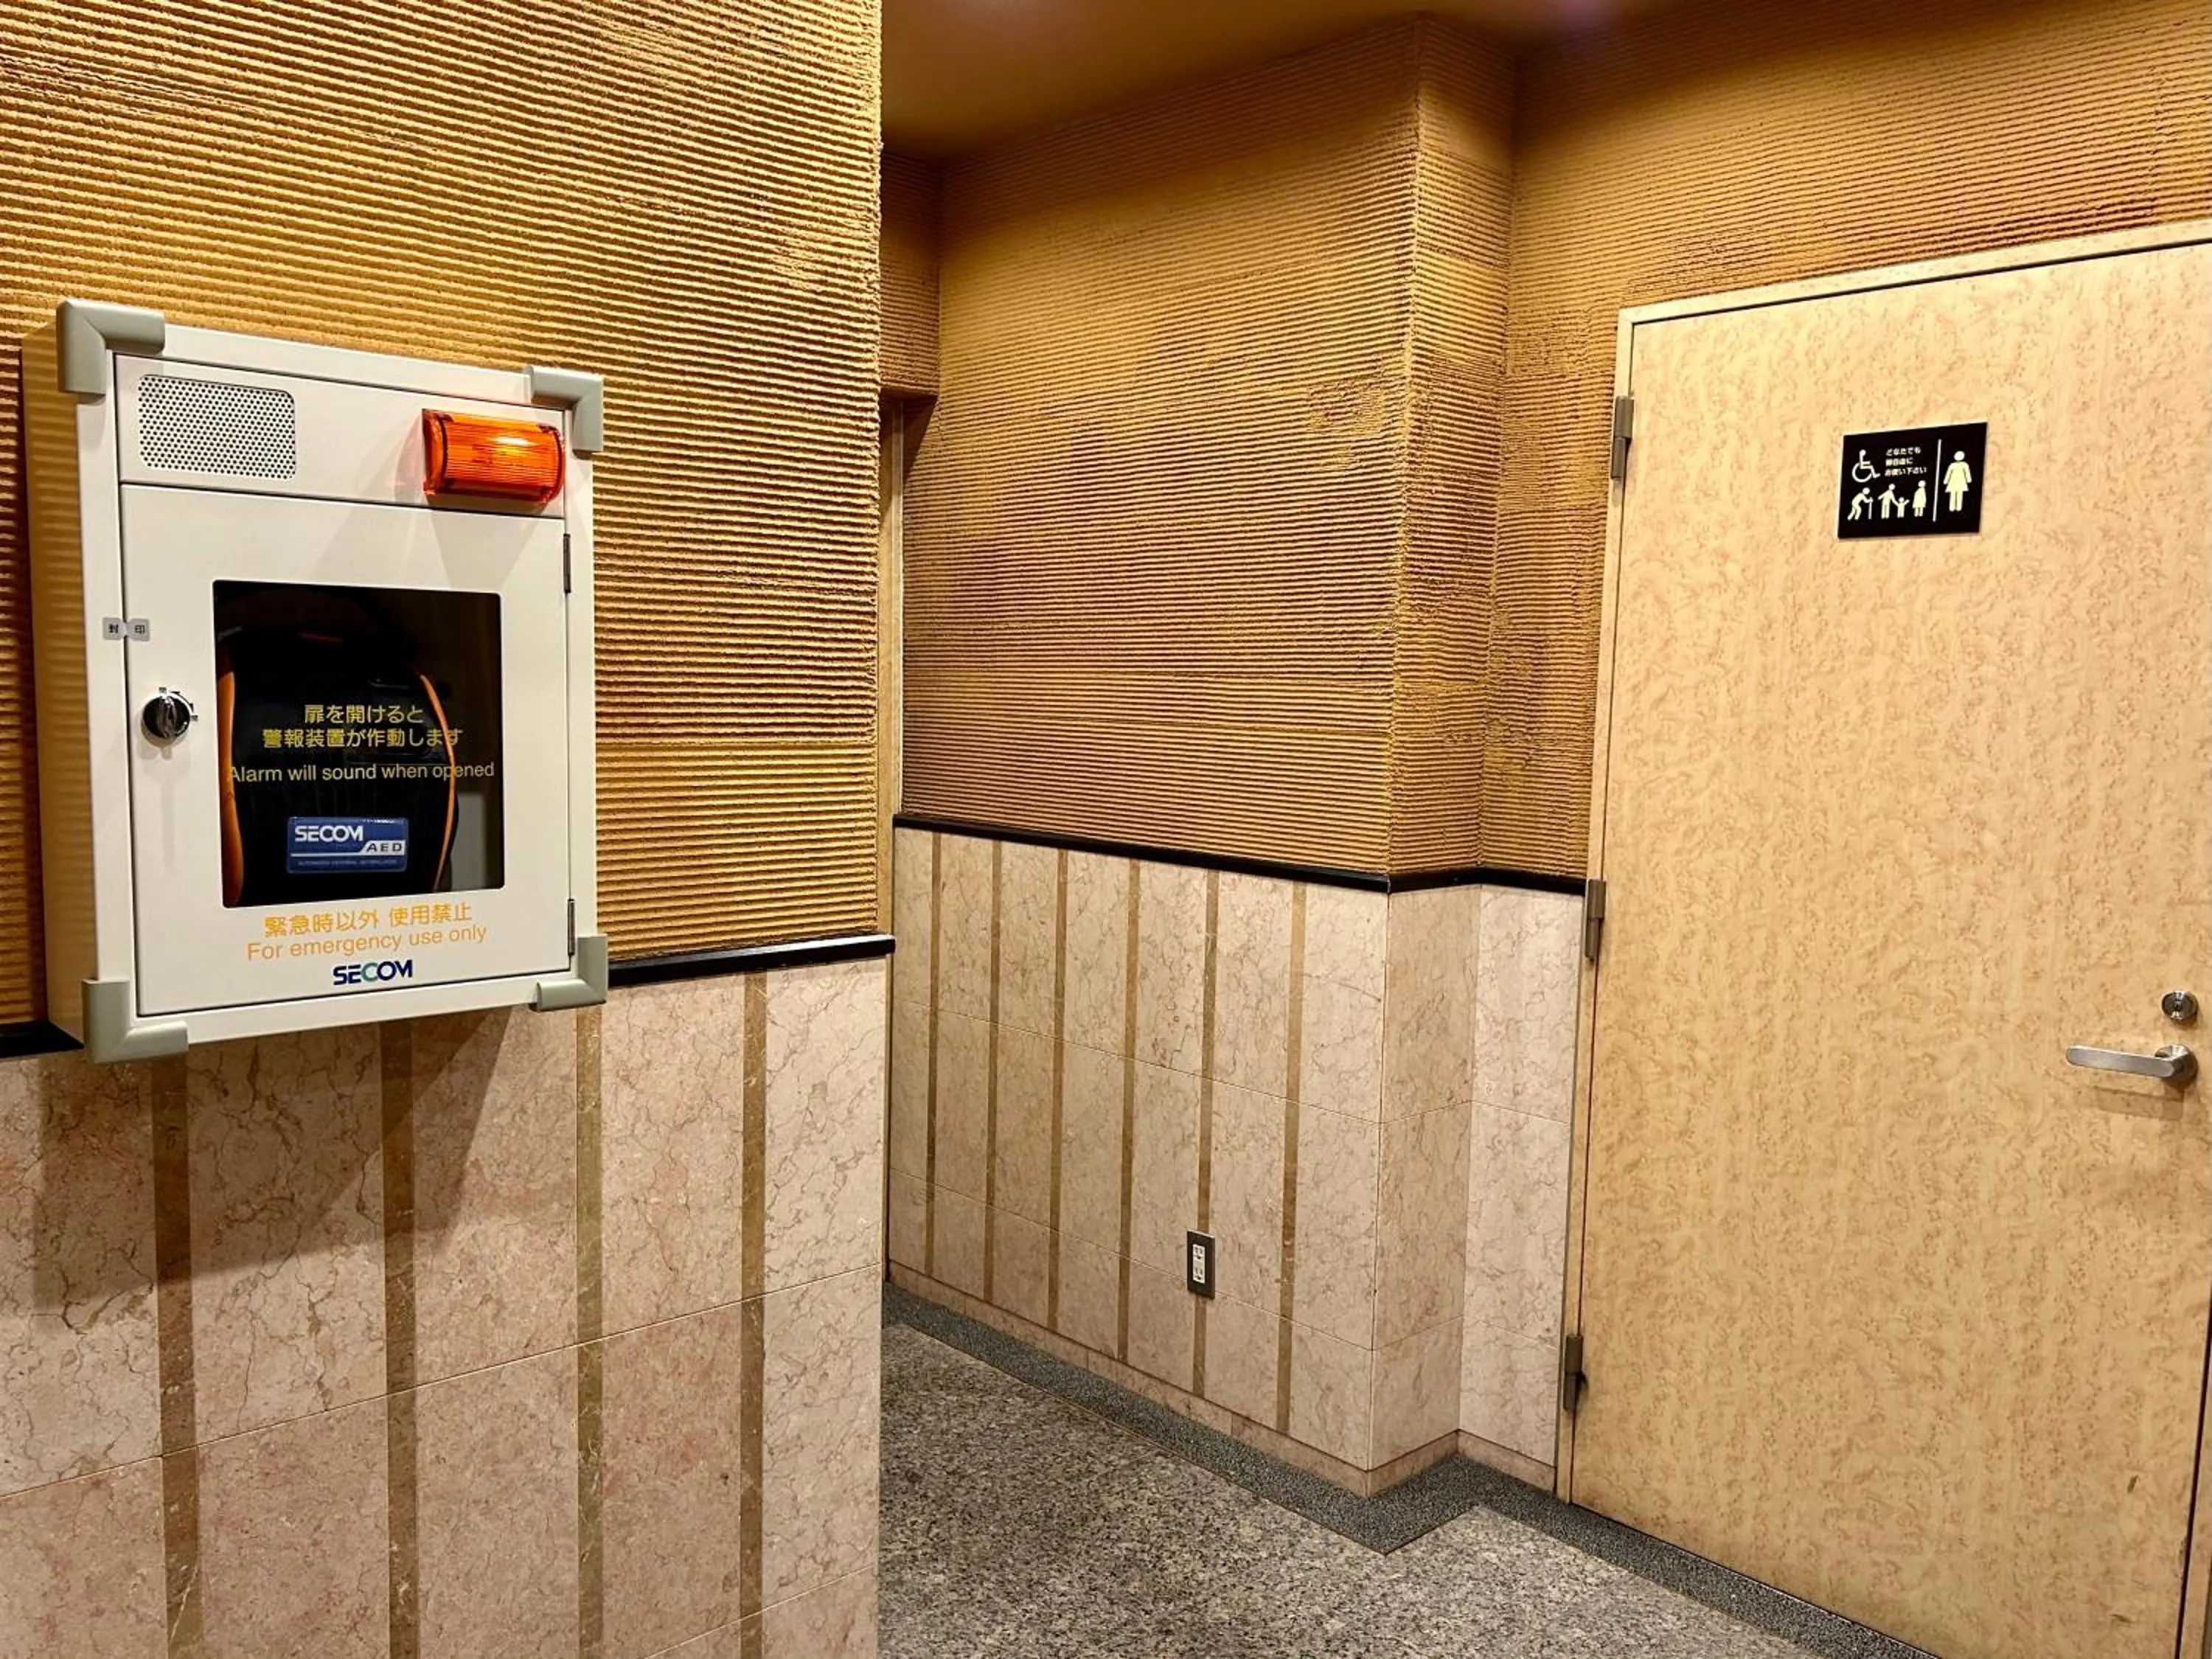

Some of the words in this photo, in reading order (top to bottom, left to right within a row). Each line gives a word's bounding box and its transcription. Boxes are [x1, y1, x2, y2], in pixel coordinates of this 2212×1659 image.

[305, 704, 423, 725] 扉を開けると
[262, 728, 463, 749] 警報装置が作動します
[229, 765, 283, 782] Alarm
[287, 765, 317, 781] will
[321, 764, 377, 780] sound
[380, 762, 428, 779] when
[434, 762, 495, 782] opened
[294, 824, 364, 843] SECOM
[367, 842, 403, 853] AED
[264, 909, 379, 938] 緊急時以外
[389, 902, 473, 927] 使用禁止
[248, 942, 283, 960] For
[290, 933, 403, 957] emergency
[409, 928, 443, 946] use
[448, 925, 487, 944] only
[333, 959, 414, 985] SECOM
